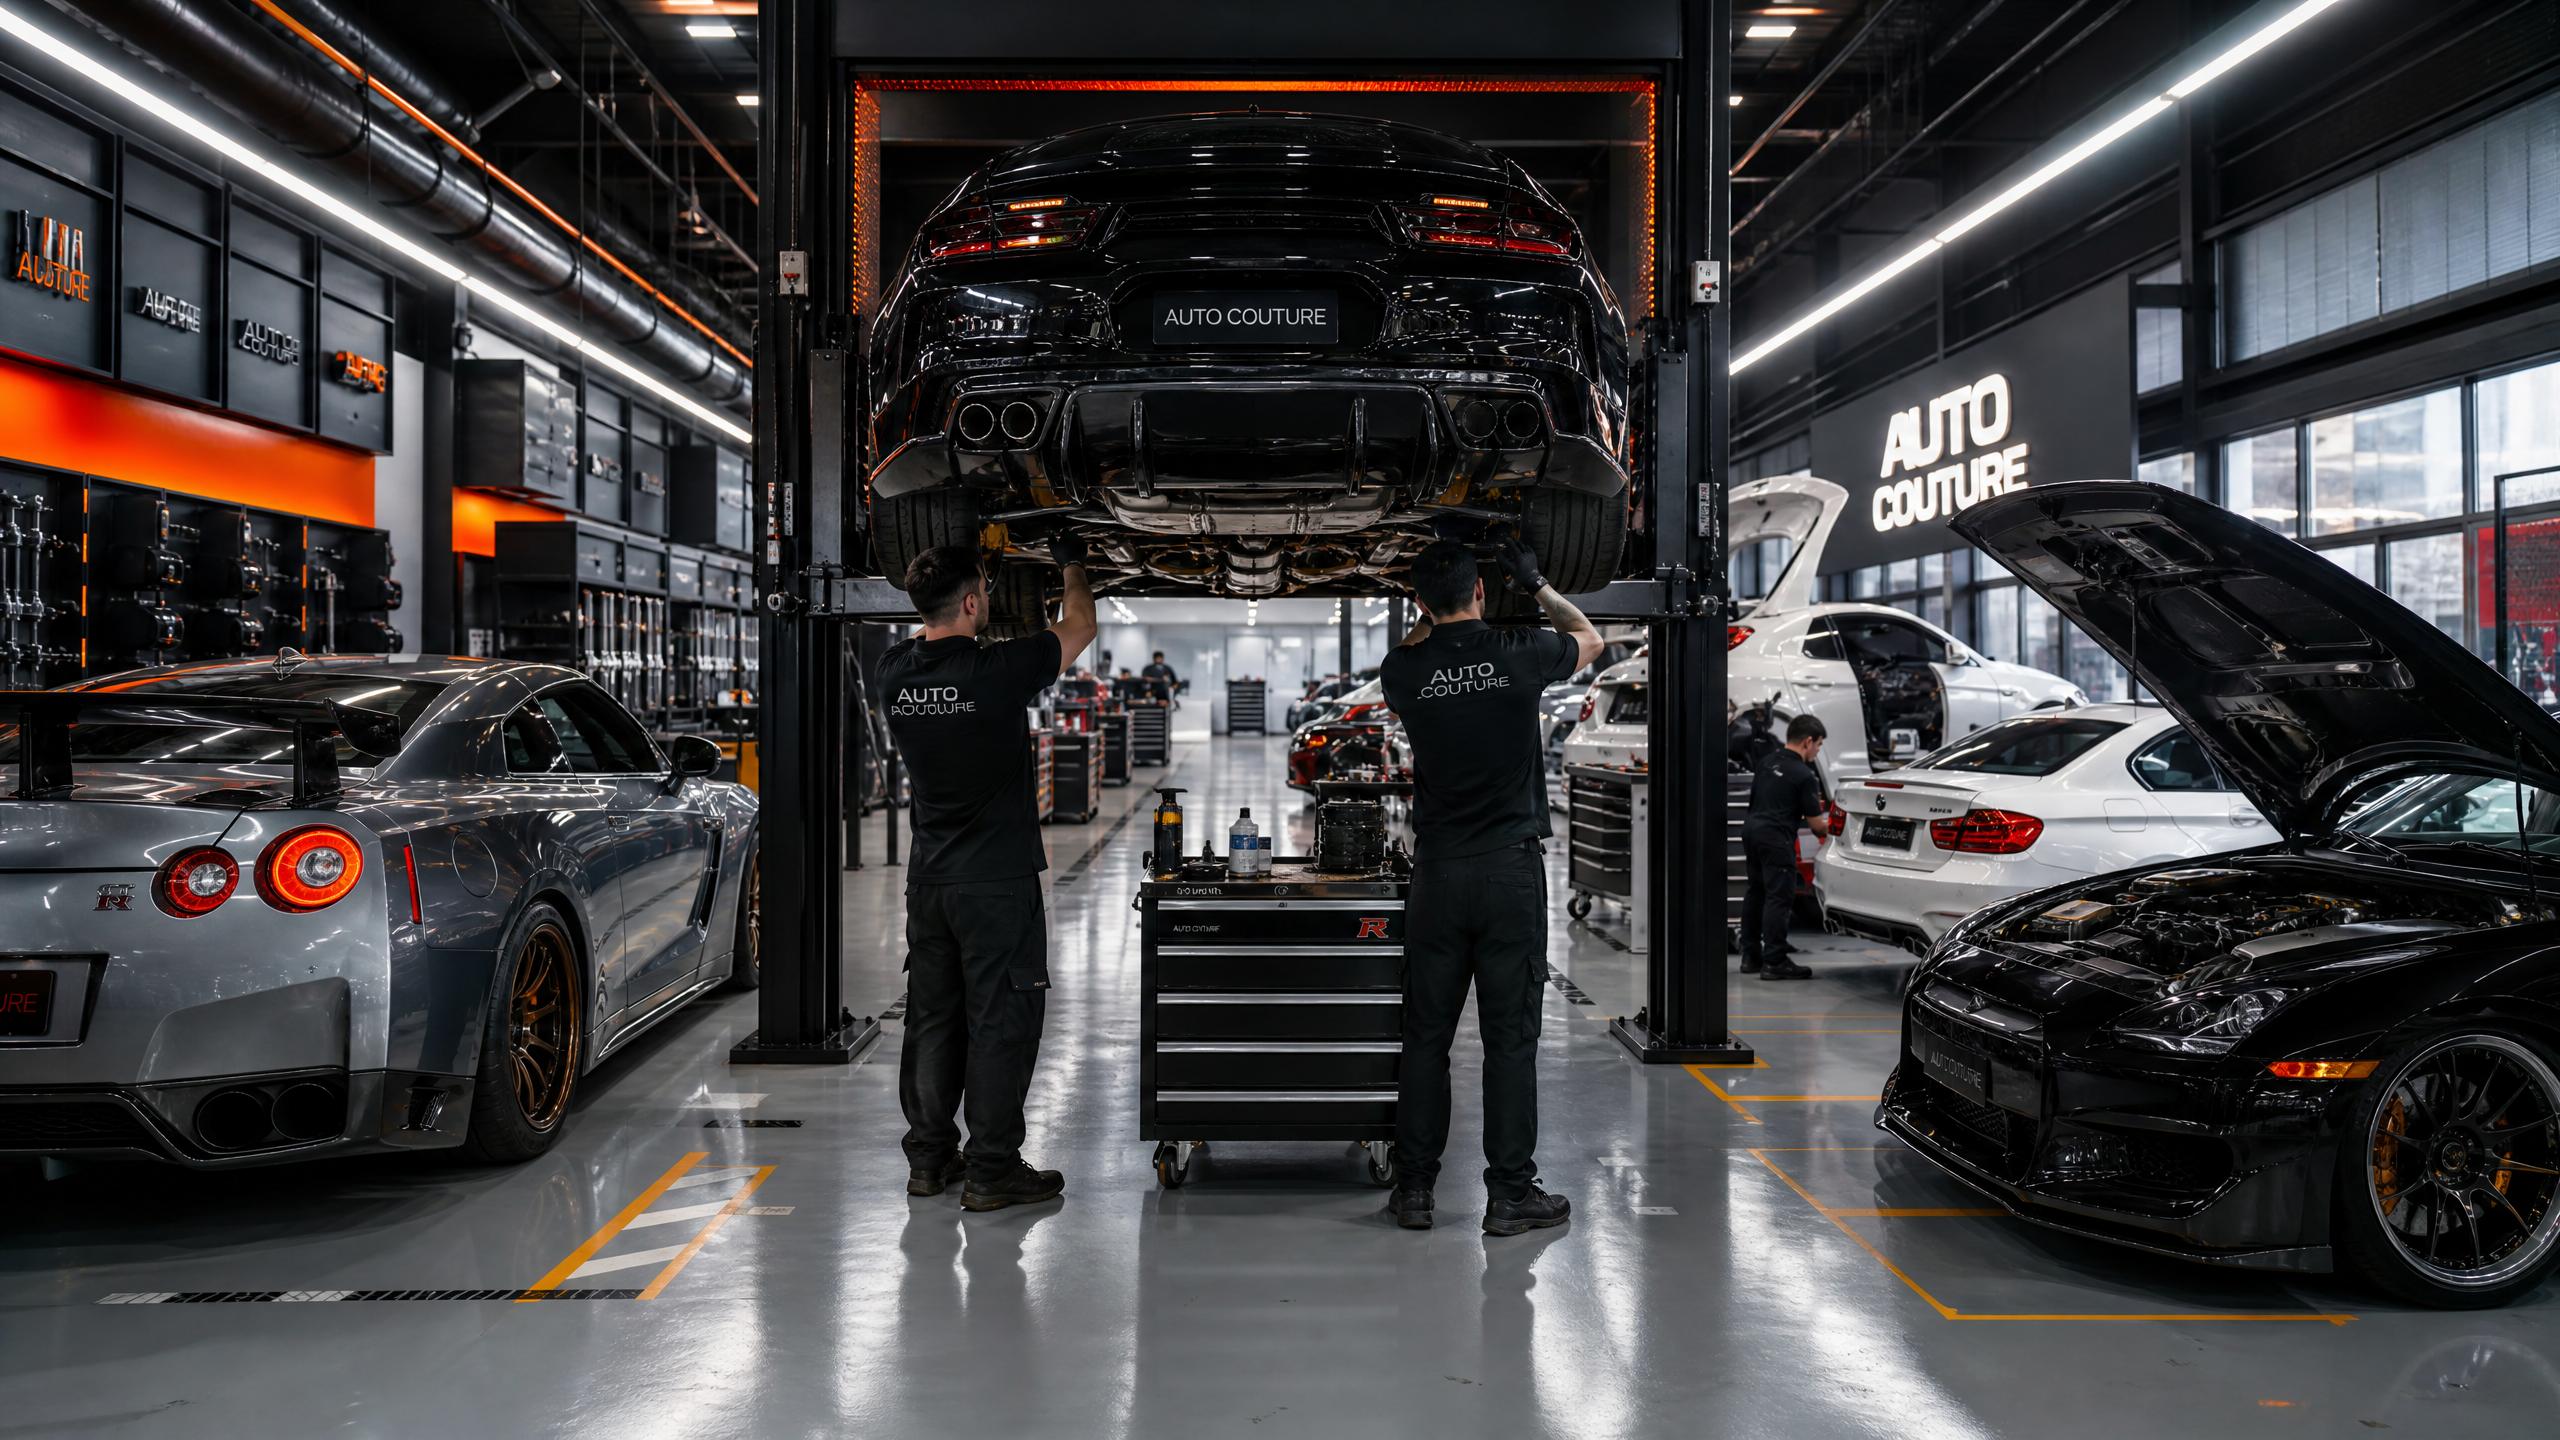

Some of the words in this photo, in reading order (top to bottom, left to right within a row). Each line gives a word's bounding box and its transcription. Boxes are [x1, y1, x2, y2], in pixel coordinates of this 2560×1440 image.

[1164, 308, 1222, 325] AUTO
[1227, 308, 1327, 325] COUTURE
[1880, 373, 2011, 478] AUTO
[1872, 443, 2030, 532] COUTURE
[1430, 662, 1495, 684] AUTO
[897, 686, 959, 703] AUTO
[1356, 917, 1390, 939] R
